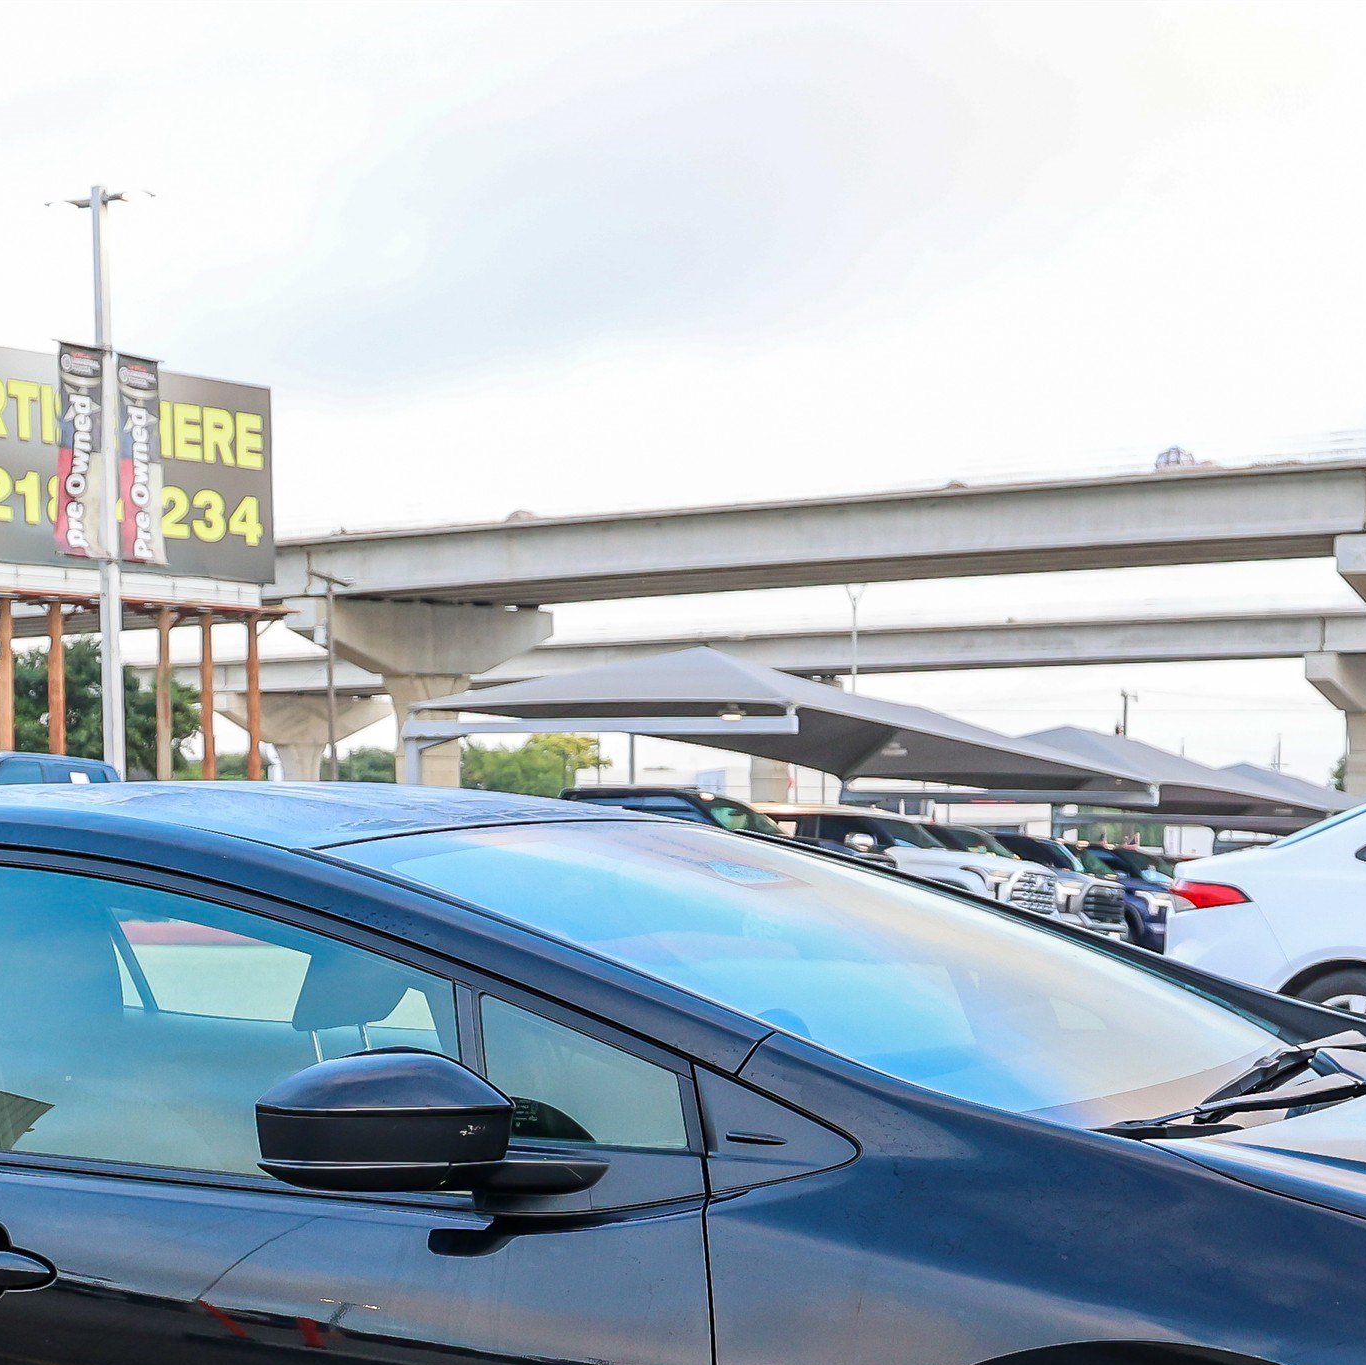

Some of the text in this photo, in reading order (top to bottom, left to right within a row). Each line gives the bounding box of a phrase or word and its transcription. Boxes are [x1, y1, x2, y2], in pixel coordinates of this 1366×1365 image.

[65, 394, 92, 498] Owned
[127, 405, 151, 507] Owned
[133, 511, 154, 557] Pre
